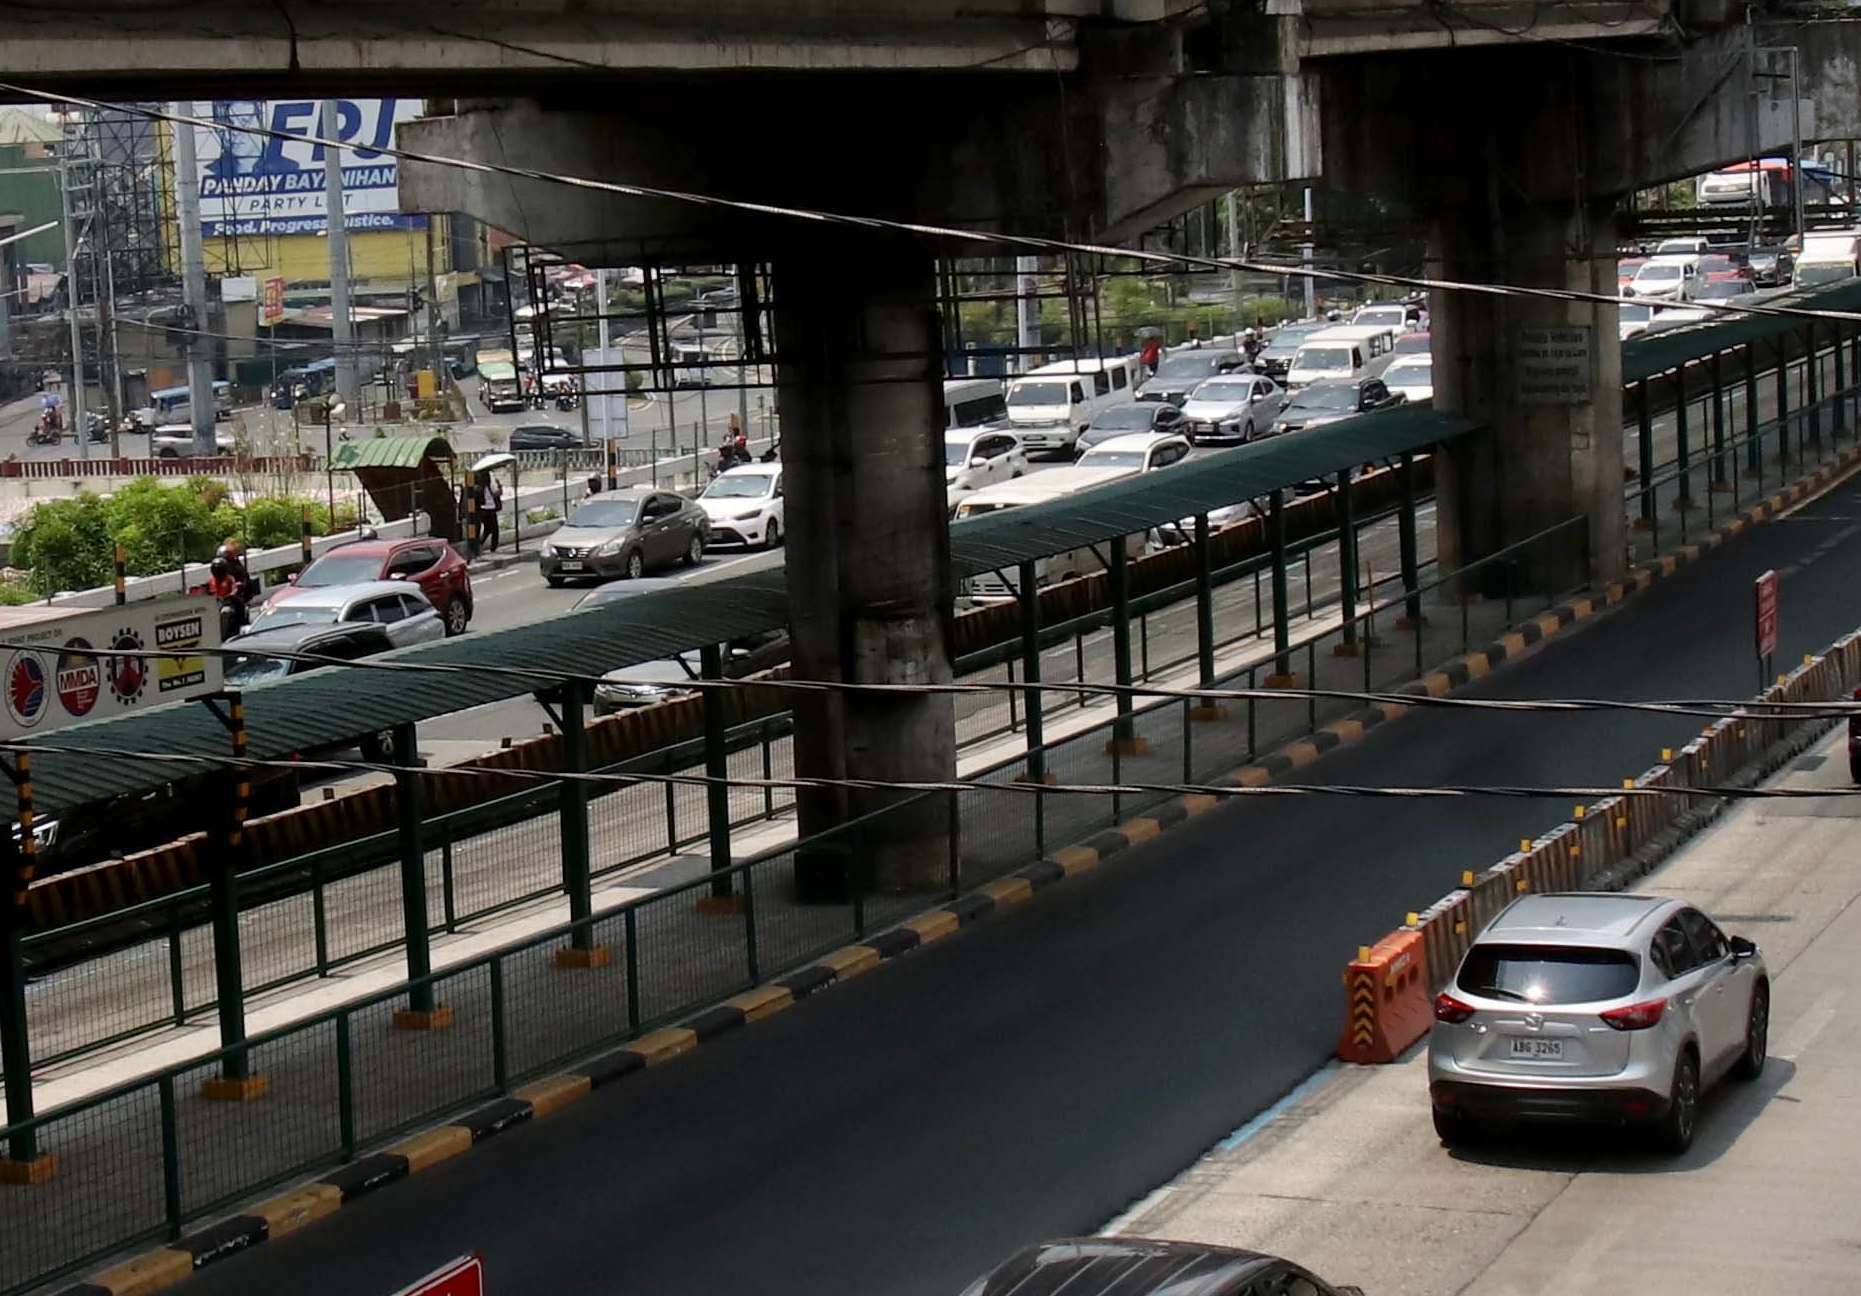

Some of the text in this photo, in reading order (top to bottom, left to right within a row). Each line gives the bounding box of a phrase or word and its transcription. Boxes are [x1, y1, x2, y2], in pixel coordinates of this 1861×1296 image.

[265, 97, 398, 163] FPJ
[203, 166, 397, 196] PANDAY BAYNIHAN
[250, 194, 353, 211] PARTY LT
[343, 214, 395, 229] ustice.
[157, 620, 201, 641] BOYSEN
[60, 667, 98, 689] MMDA
